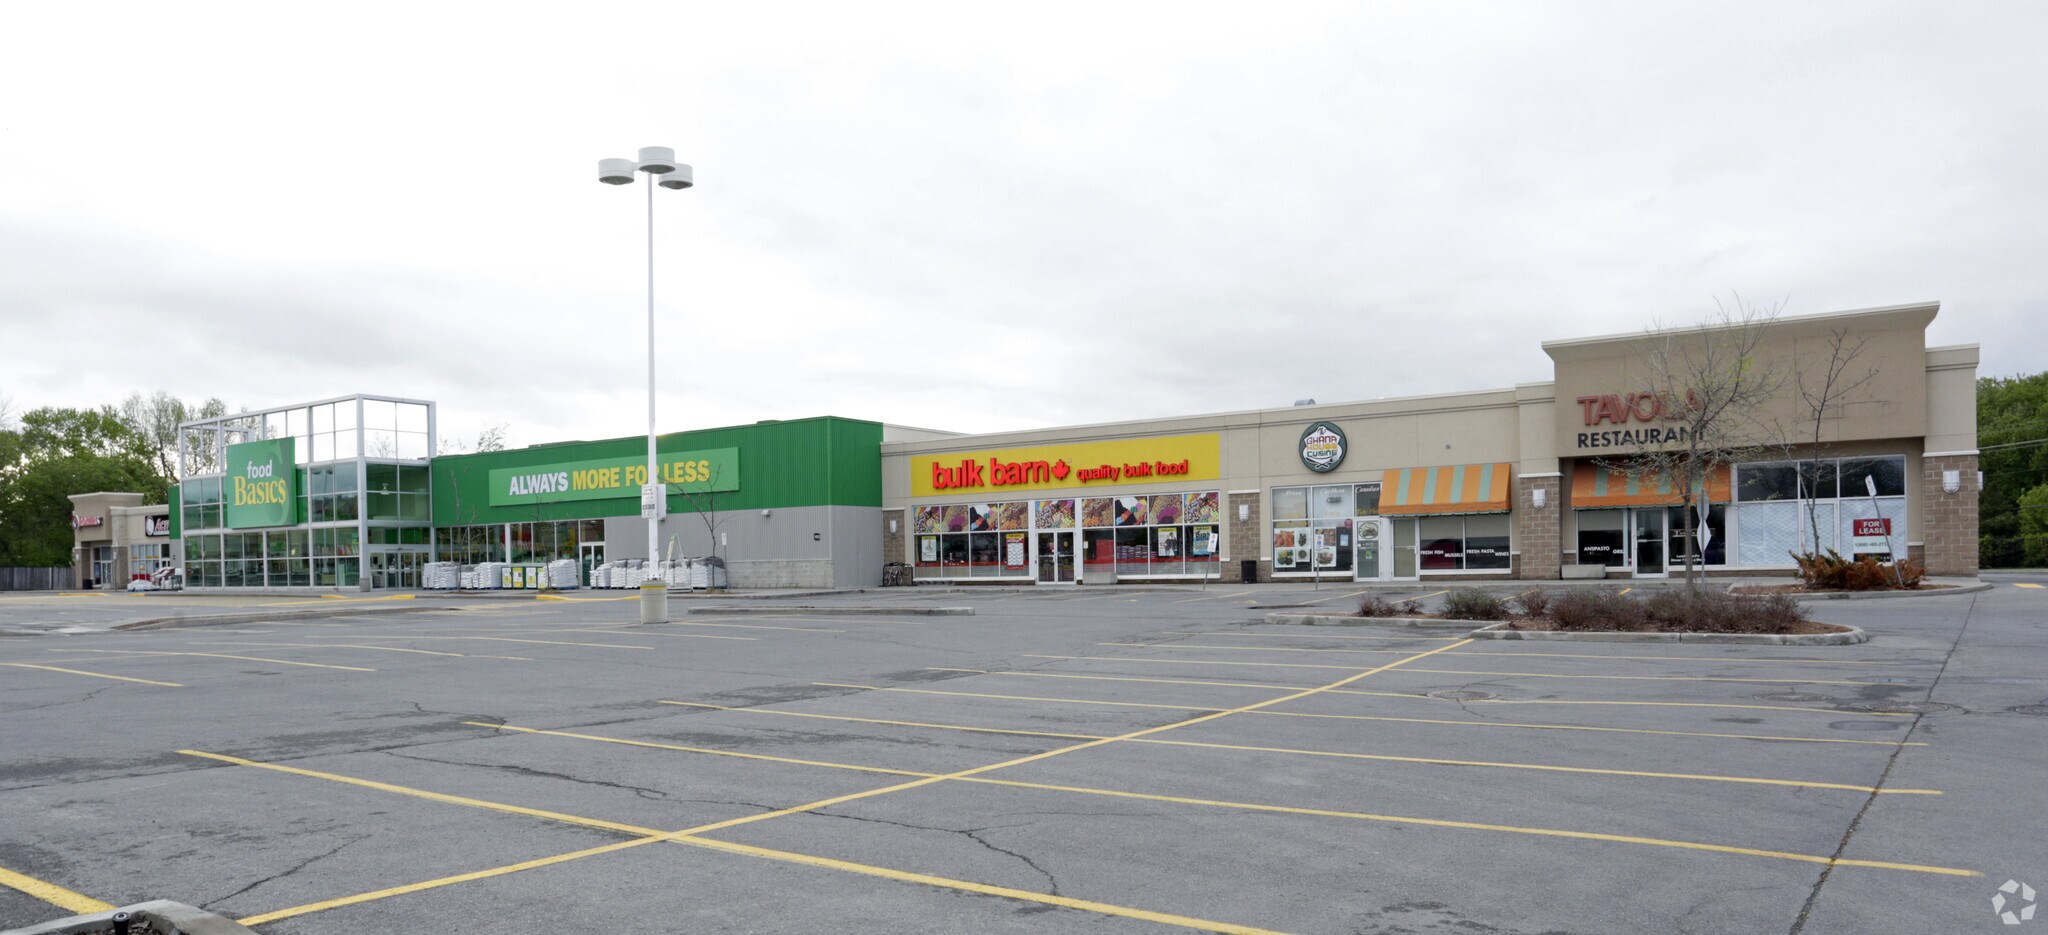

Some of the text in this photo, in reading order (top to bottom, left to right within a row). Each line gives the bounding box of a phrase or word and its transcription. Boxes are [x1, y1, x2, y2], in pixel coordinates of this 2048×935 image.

[1306, 435, 1338, 445] GHANA
[1306, 450, 1338, 458] CUISINE
[246, 459, 273, 479] food
[509, 459, 711, 496] ALWAYS MORE FO LESS
[932, 457, 1050, 489] bulk barn
[1076, 459, 1189, 484] quality bulk food
[1858, 527, 1885, 535] LEASE
